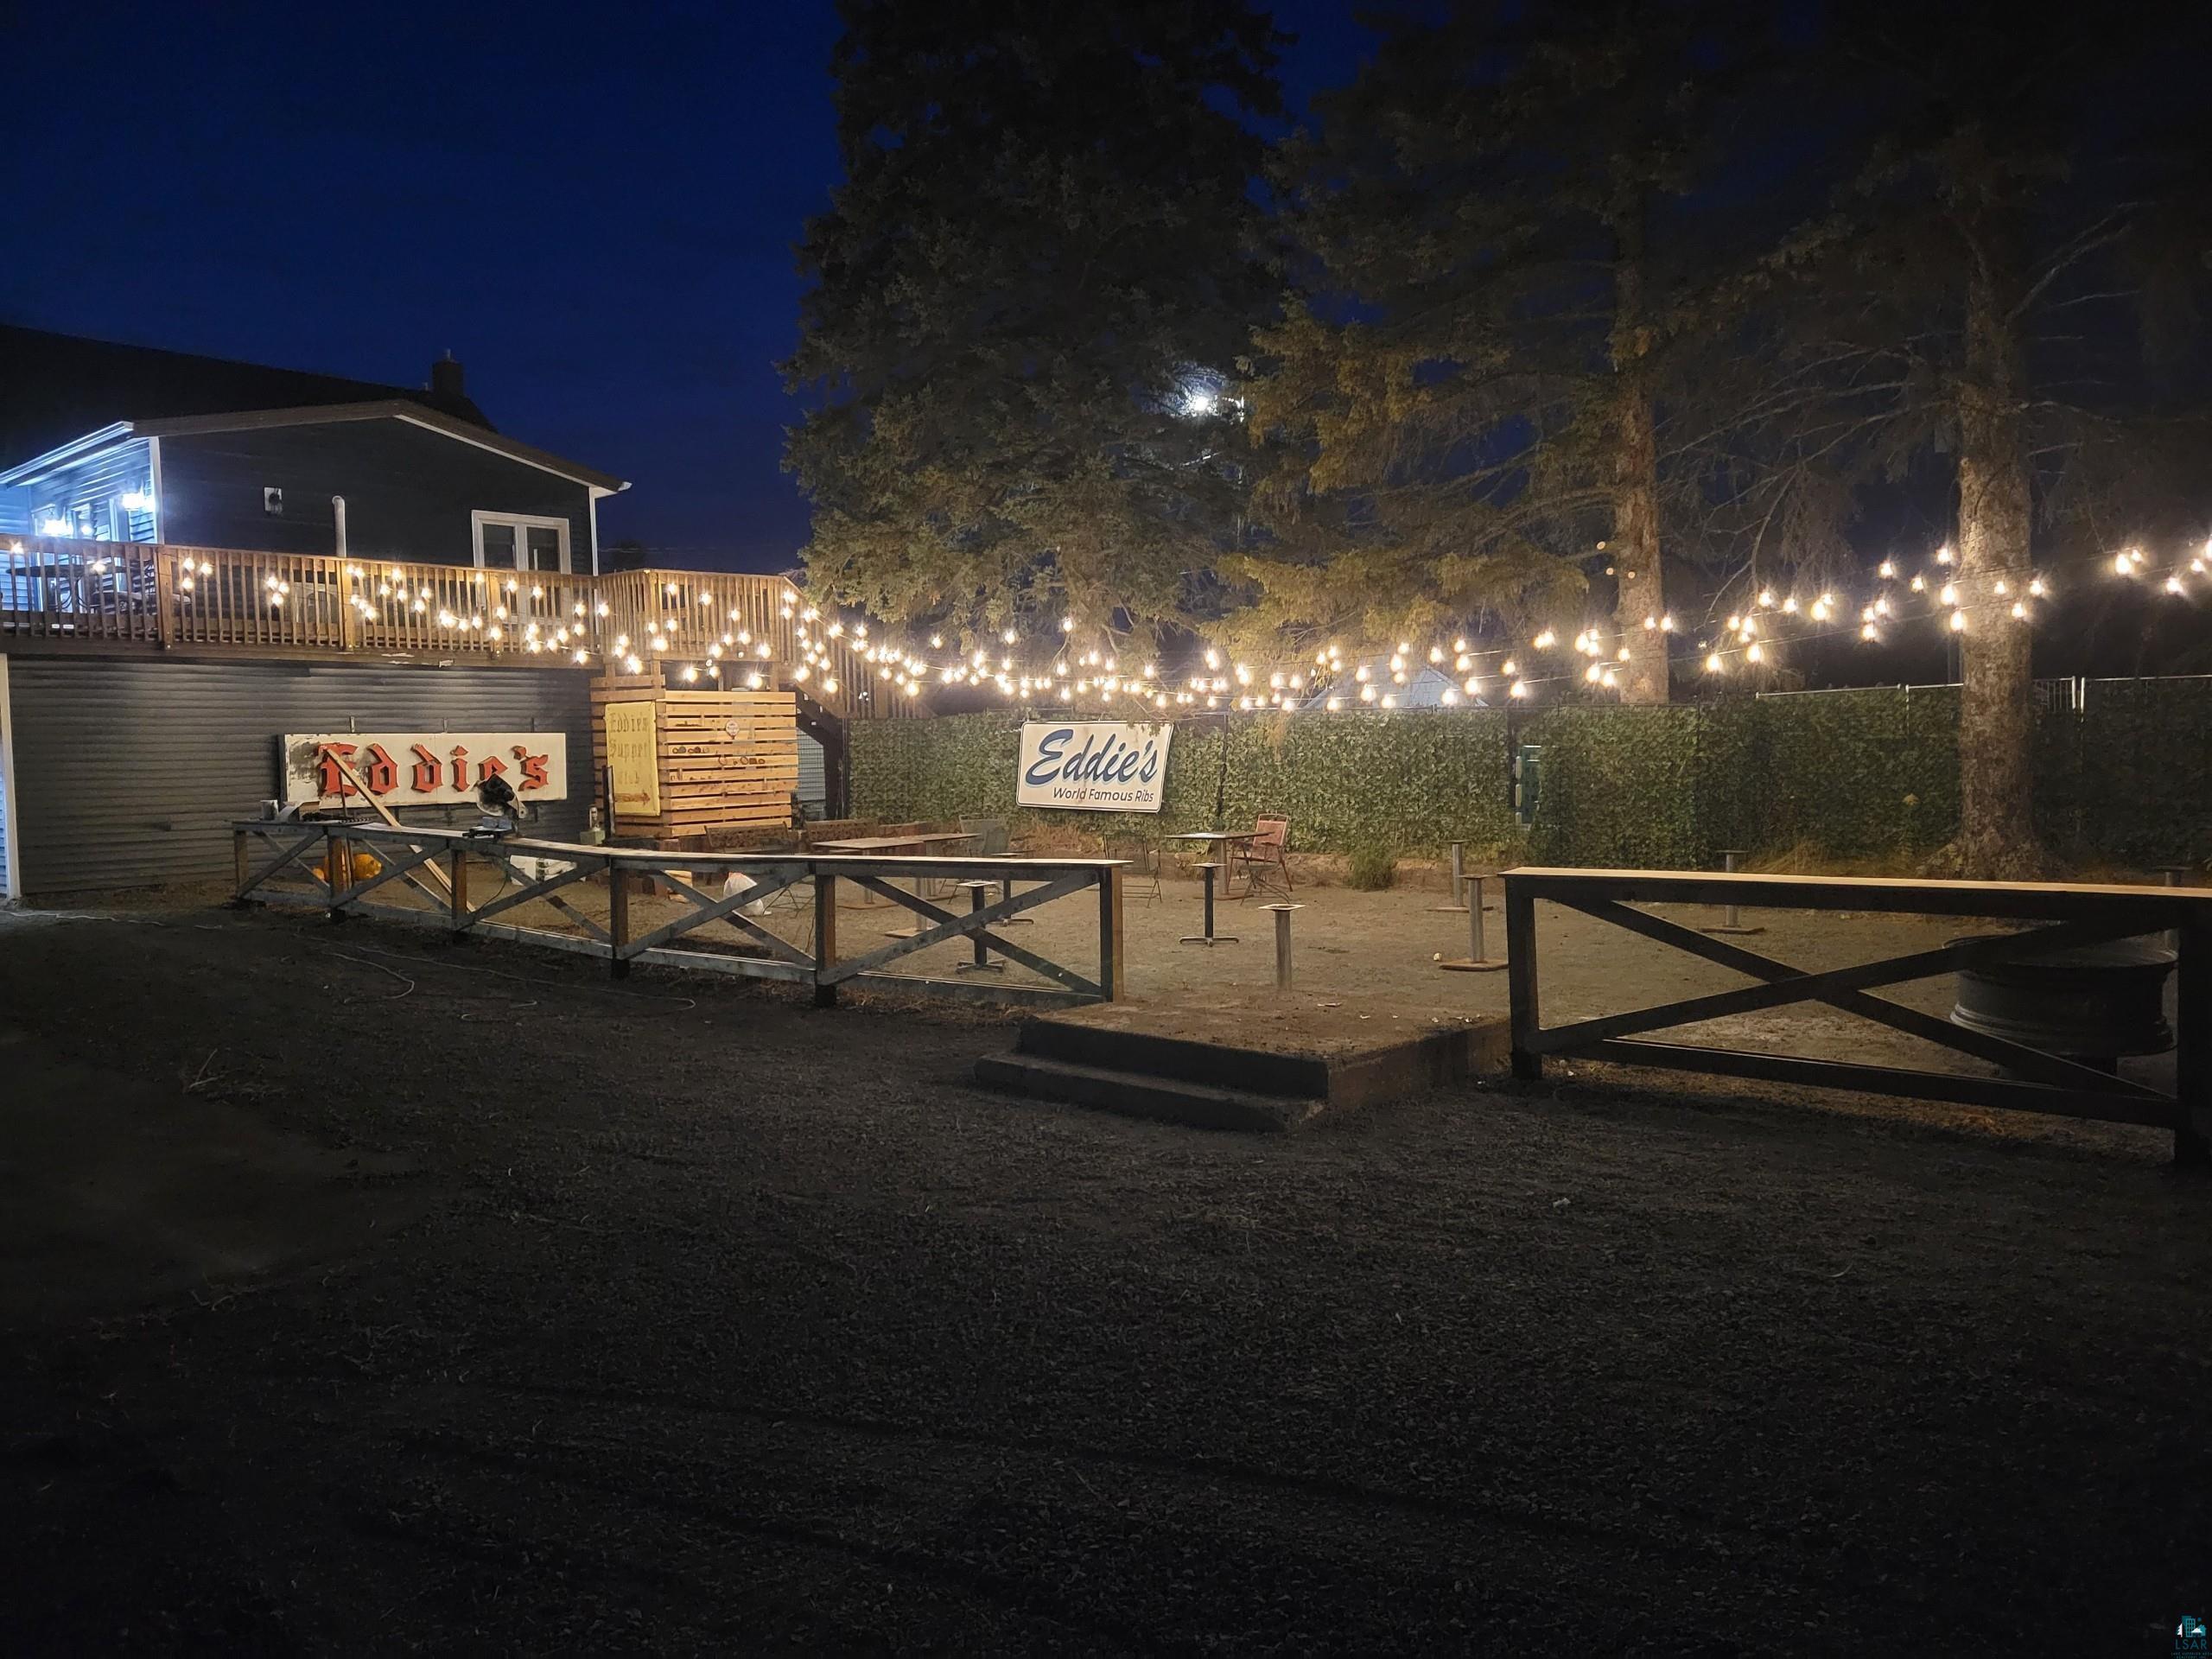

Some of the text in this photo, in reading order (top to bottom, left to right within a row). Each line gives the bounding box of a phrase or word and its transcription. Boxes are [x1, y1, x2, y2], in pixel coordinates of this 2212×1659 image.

[1025, 728, 1159, 786] Eddie's
[1052, 787, 1154, 803] World Famous Ribs
